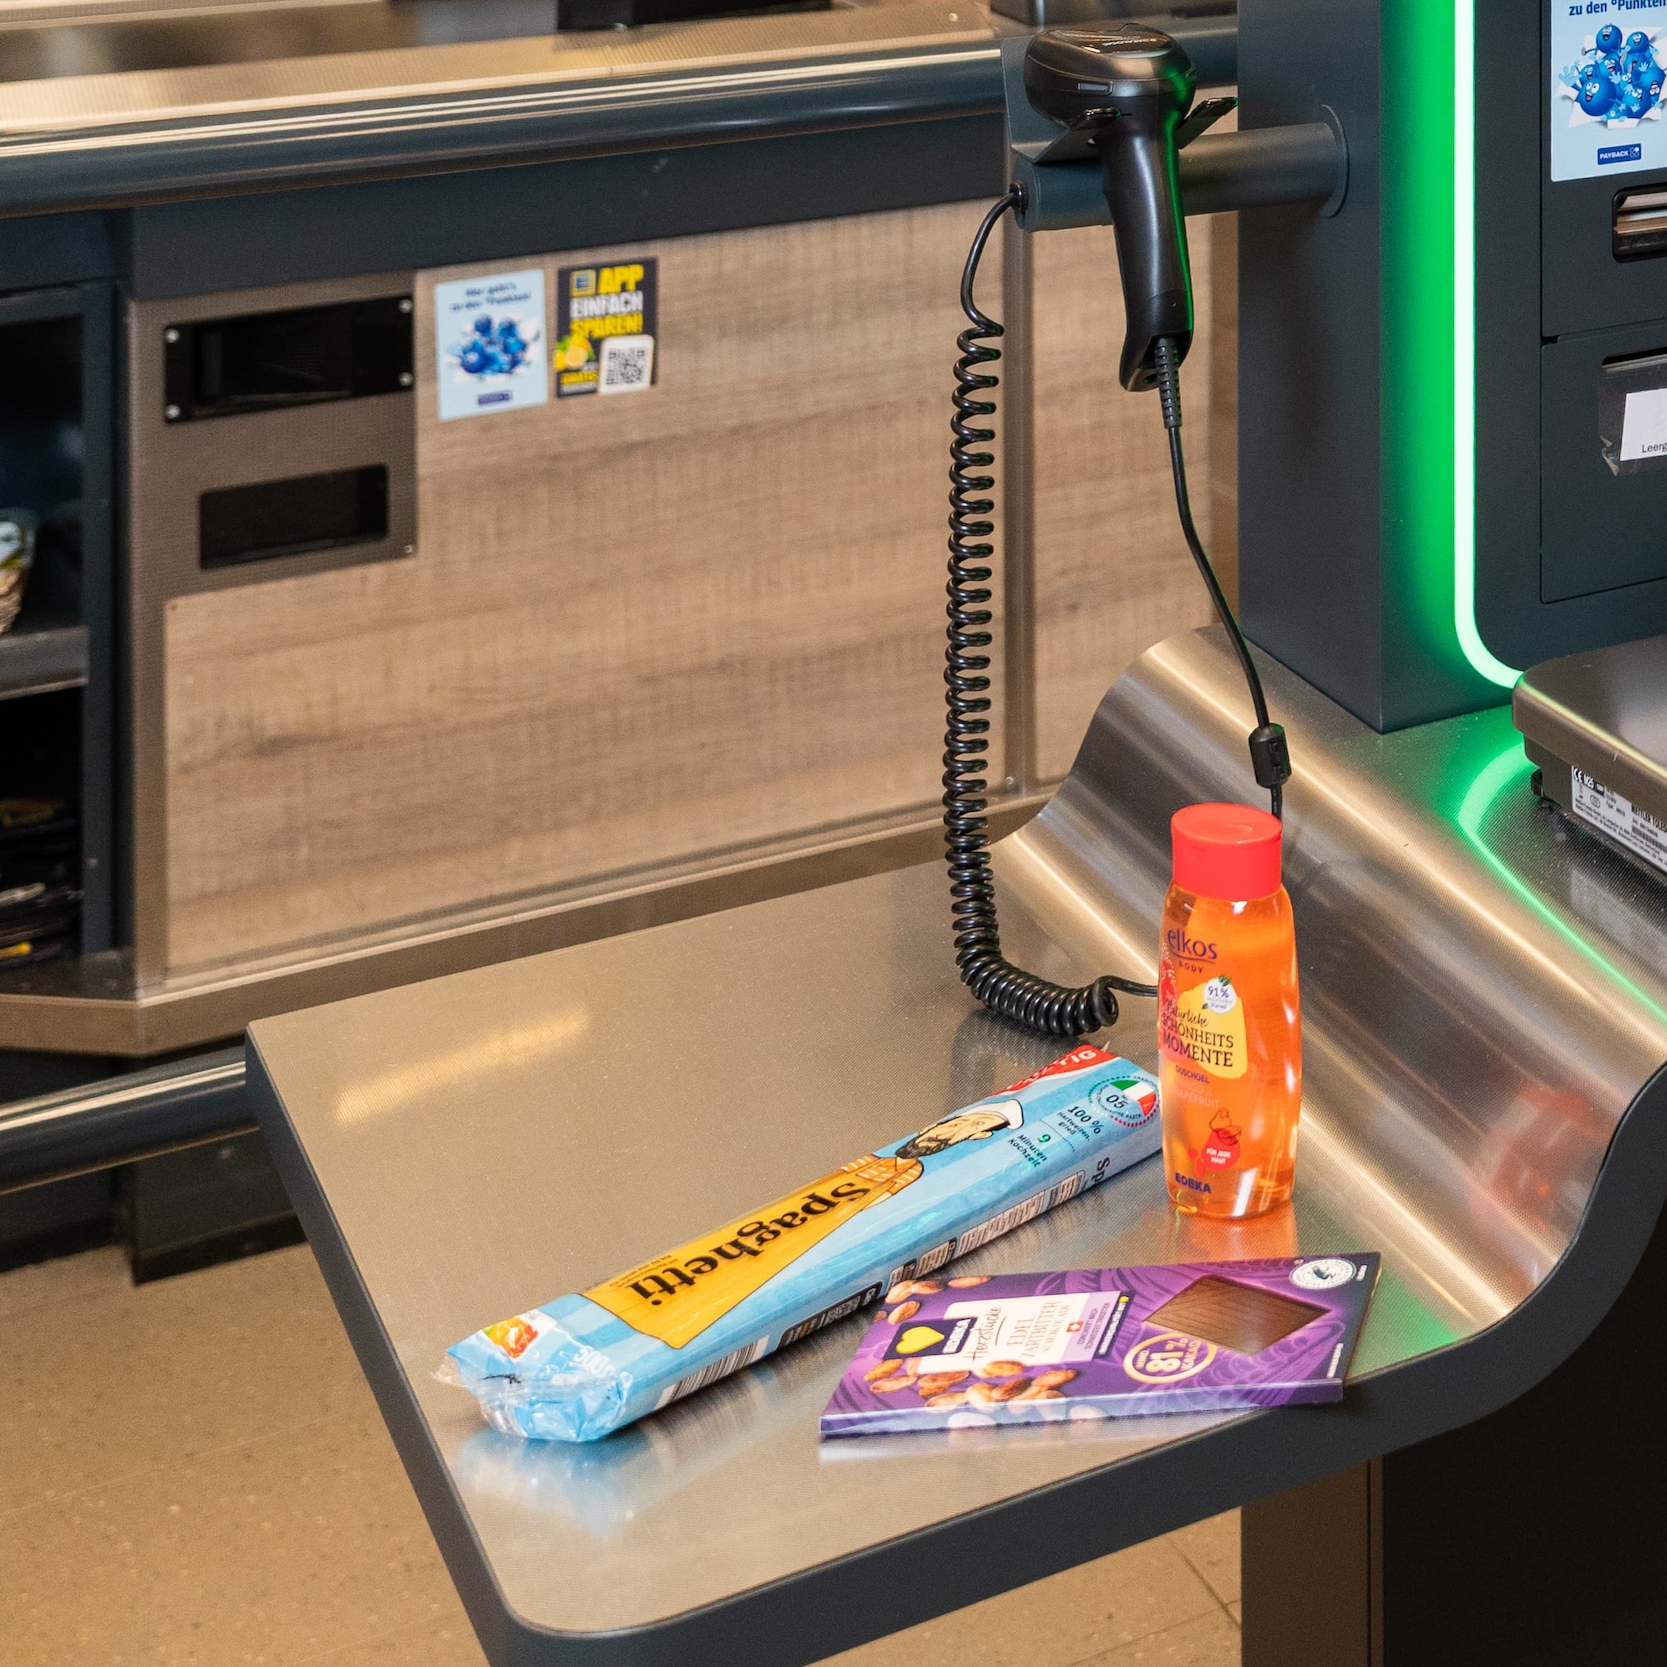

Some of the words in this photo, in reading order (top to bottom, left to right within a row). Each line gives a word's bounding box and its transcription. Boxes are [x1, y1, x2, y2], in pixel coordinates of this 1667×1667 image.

[1569, 5, 1583, 16] zu
[1586, 1, 1607, 14] den
[1599, 150, 1629, 160] PAYBACK
[598, 264, 644, 295] APP
[570, 290, 643, 320] EINFACH
[1167, 928, 1218, 960] elkos
[1178, 961, 1204, 974] BODY
[1162, 1012, 1234, 1048] SCHÖNHEITS
[1162, 1029, 1234, 1067] MOMENTE
[1175, 1064, 1209, 1084] DUSCHGEL
[1067, 1105, 1092, 1123] 100
[1105, 1094, 1128, 1109] 05
[1007, 1138, 1041, 1168] Kochzeit
[1017, 1133, 1048, 1162] Minuten
[1037, 1133, 1052, 1144] 9
[1206, 1147, 1217, 1156] FÜR
[1217, 1149, 1232, 1158] JEDE
[1211, 1156, 1226, 1164] HAUT
[1174, 1172, 1212, 1194] EDEKA
[626, 1181, 872, 1307] Spaghetti
[942, 1318, 972, 1353] EDEKA
[963, 1306, 1002, 1361] Herzstücke
[1180, 1340, 1202, 1371] KAKAO
